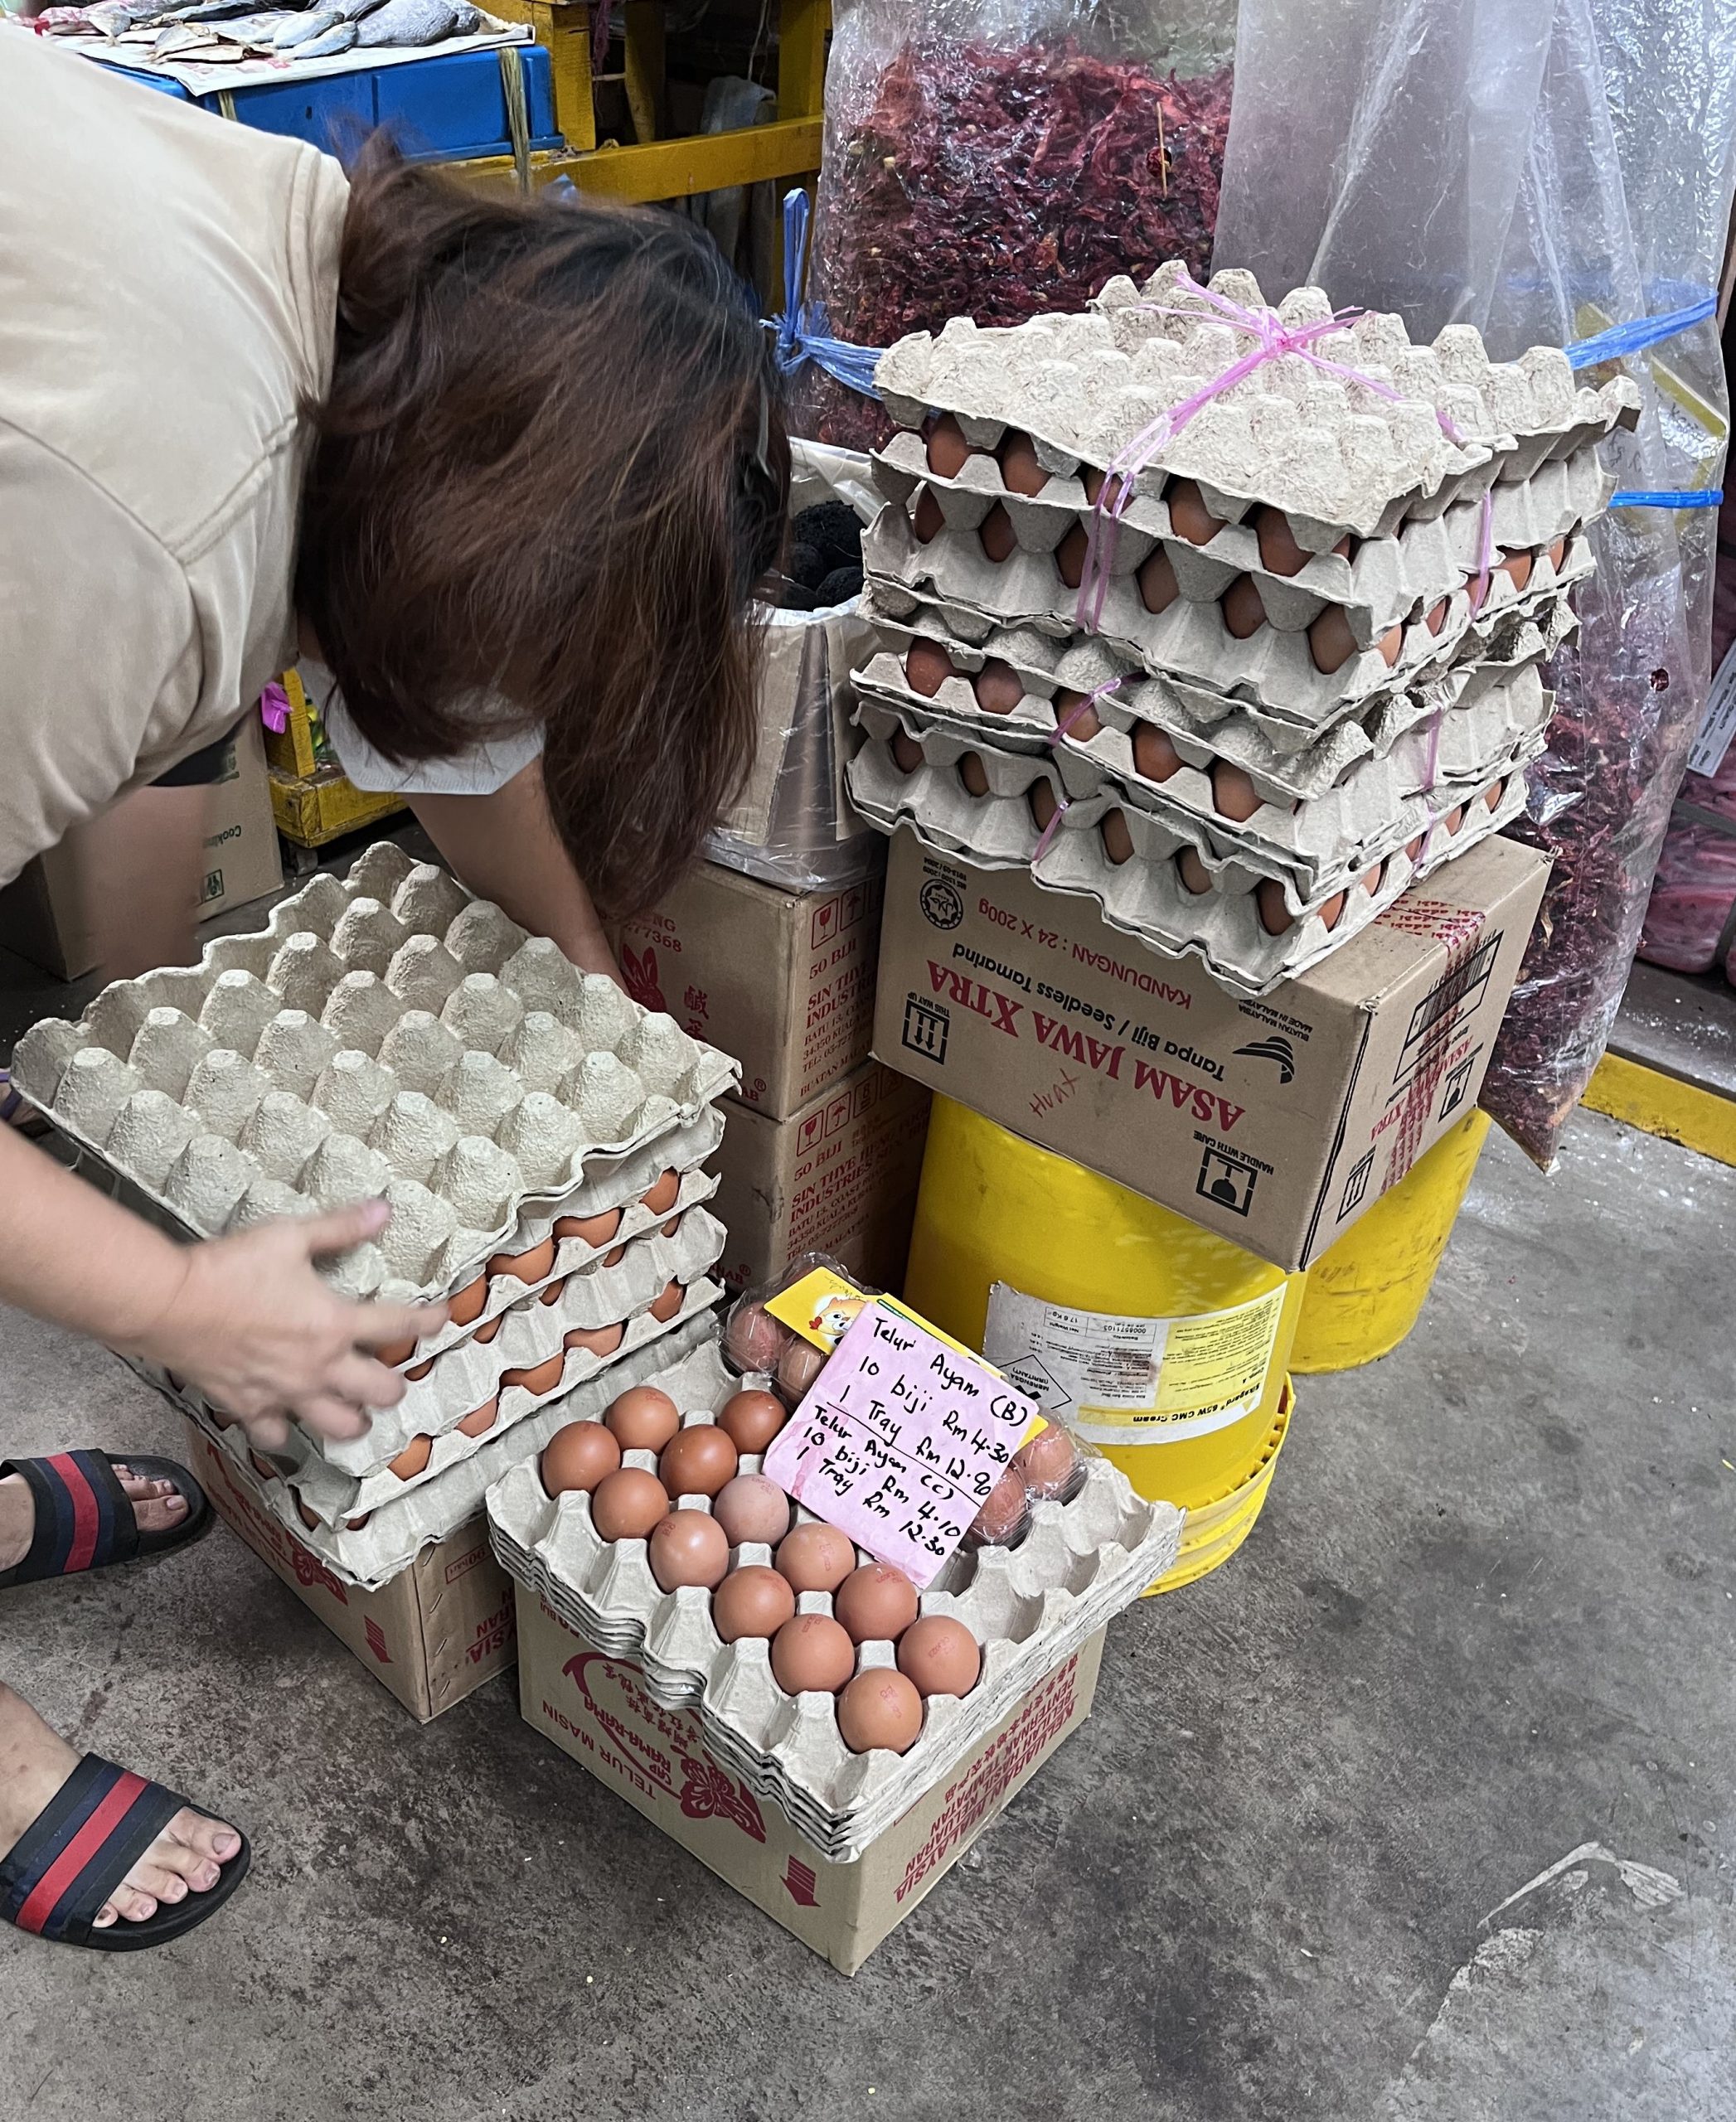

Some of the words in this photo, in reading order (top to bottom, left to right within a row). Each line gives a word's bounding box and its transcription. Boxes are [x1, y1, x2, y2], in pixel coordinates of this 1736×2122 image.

[979, 898, 1017, 930] 200g
[1039, 928, 1059, 948] 24
[809, 958, 827, 980] 50
[832, 938, 856, 966] BIJI
[953, 942, 1031, 993] Tamarind
[1073, 943, 1191, 1010] KANDUNGAN
[807, 984, 832, 1010] SIN
[907, 992, 918, 1001] UP
[918, 996, 934, 1010] WAY
[927, 960, 1024, 1038] XTRA
[934, 1003, 950, 1018] THIS
[1036, 982, 1116, 1030] Seedless
[1239, 1004, 1278, 1026] MALAYSIA
[1279, 1013, 1289, 1021] IN
[1032, 1010, 1126, 1080] JAWA
[1118, 1020, 1130, 1035] /
[1131, 1026, 1161, 1051] Biji
[1278, 1024, 1310, 1042] BUATAN
[1288, 1018, 1313, 1034] MADE
[1164, 1040, 1225, 1082] Tanpa
[1132, 1059, 1246, 1131] ASAM
[794, 1162, 812, 1181] 50
[815, 1141, 842, 1169] BIJI
[1193, 1130, 1216, 1147] CARE
[1217, 1141, 1240, 1158] WITH
[1241, 1151, 1274, 1175] HANDLE
[790, 1161, 873, 1223] INDUSTRIES
[792, 1182, 817, 1209] SIN
[820, 1155, 856, 1186] THYE
[859, 1356, 880, 1375] 10
[890, 1374, 933, 1414] biji
[873, 1317, 916, 1350] Telur
[930, 1354, 979, 1397] Ayam
[991, 1395, 1027, 1427] (B)
[815, 1405, 852, 1439] Telur
[865, 1439, 907, 1474] Ayam
[840, 1385, 851, 1403] 1
[868, 1400, 903, 1446] Tray
[797, 1446, 810, 1461] 1
[818, 1458, 854, 1497] Tray
[899, 1520, 945, 1556] 12.30
[803, 1427, 825, 1446] 10
[835, 1446, 870, 1475] biji
[918, 1500, 961, 1537] 4.10
[542, 1699, 594, 1751] MASIN
[584, 1696, 672, 1773] RAMA-RAMA
[1004, 1671, 1075, 1758] PENTERNAK
[1023, 1688, 1073, 1751] BELILAH
[599, 1745, 657, 1800] TELUR
[649, 1764, 672, 1785] CAP
[983, 1747, 1020, 1794] HASIL
[990, 1700, 1075, 1805] KELUARAN
[930, 1755, 999, 1838] TEMPATAN
[896, 1798, 987, 1904] MALAYSIA
[905, 1792, 978, 1877] KELUARAN
